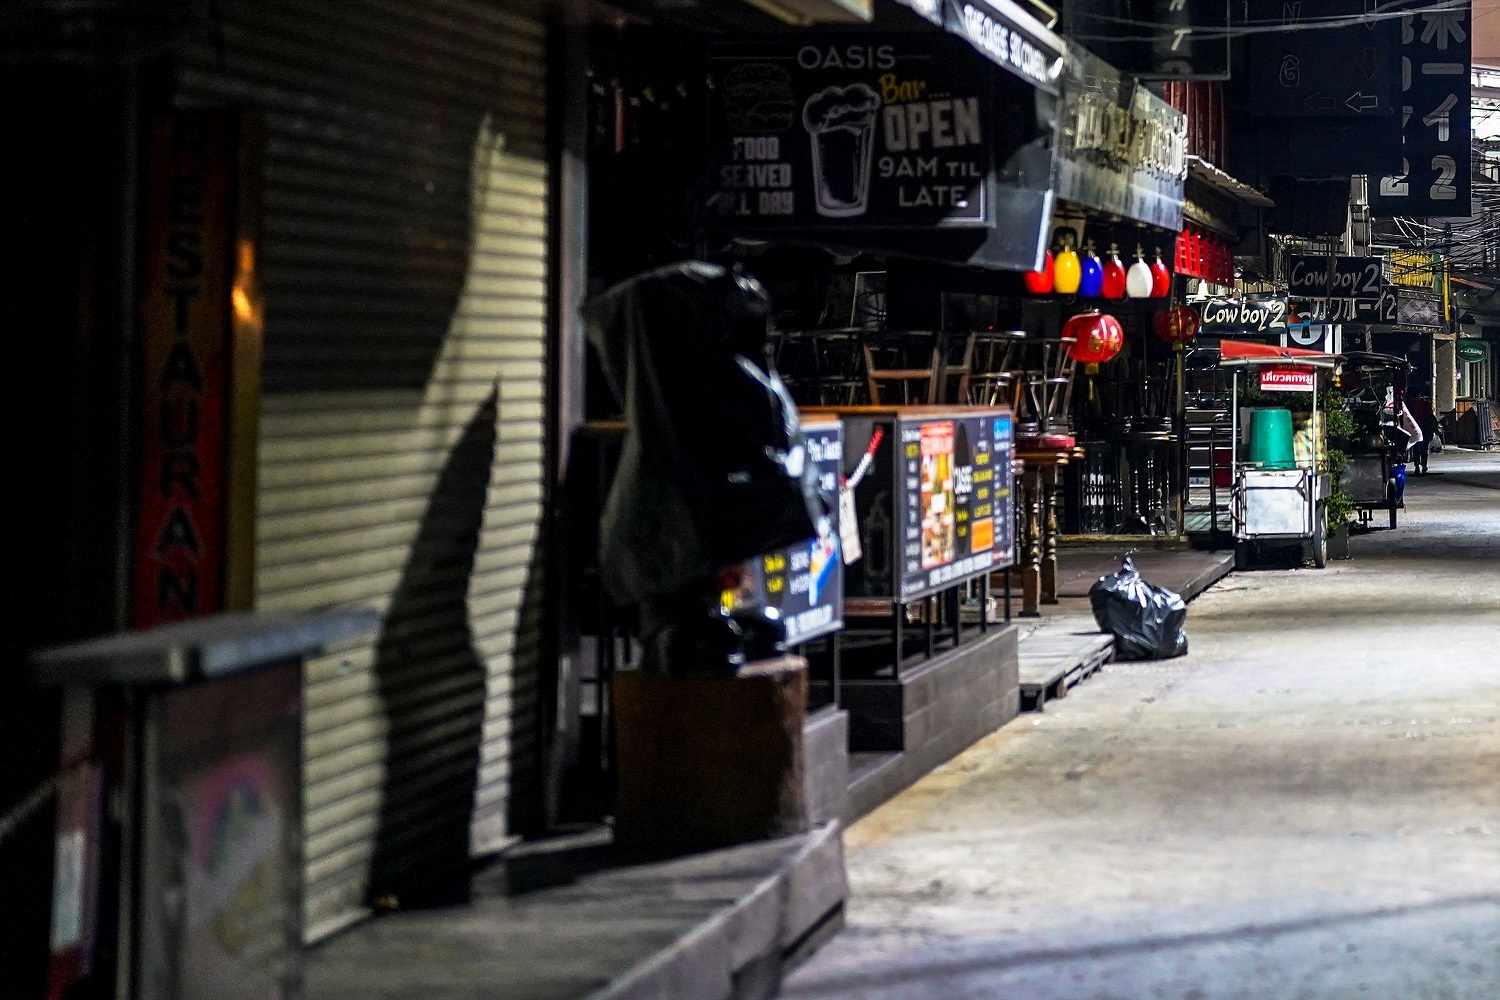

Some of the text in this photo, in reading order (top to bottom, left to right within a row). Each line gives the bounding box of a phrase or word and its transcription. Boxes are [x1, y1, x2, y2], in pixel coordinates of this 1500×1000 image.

[798, 45, 898, 71] OASIS
[882, 96, 983, 153] OPEN
[878, 155, 982, 179] 9AM TIL
[898, 185, 969, 208] LATE
[1290, 256, 1363, 297] Cowboy
[1361, 263, 1380, 293] 2
[1202, 300, 1286, 331] Cowboy 2
